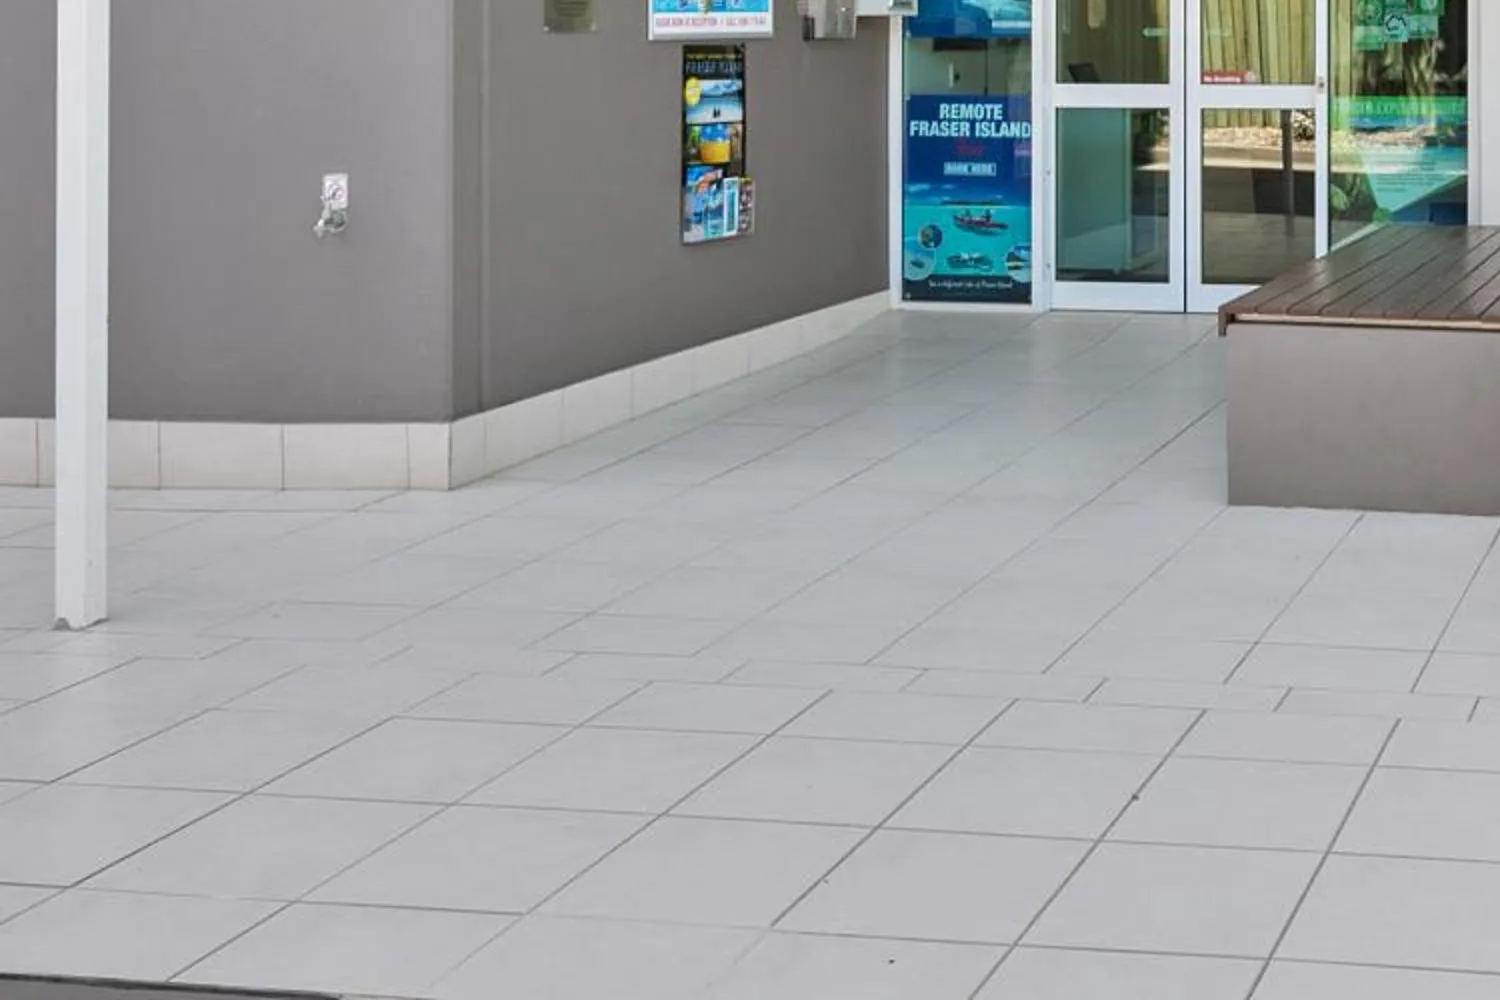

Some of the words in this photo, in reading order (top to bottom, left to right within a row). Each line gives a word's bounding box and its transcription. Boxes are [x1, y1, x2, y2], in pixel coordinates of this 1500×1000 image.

[939, 103, 1003, 120] REMOTE
[909, 120, 970, 137] FRASER
[975, 121, 1031, 138] ISLAND
